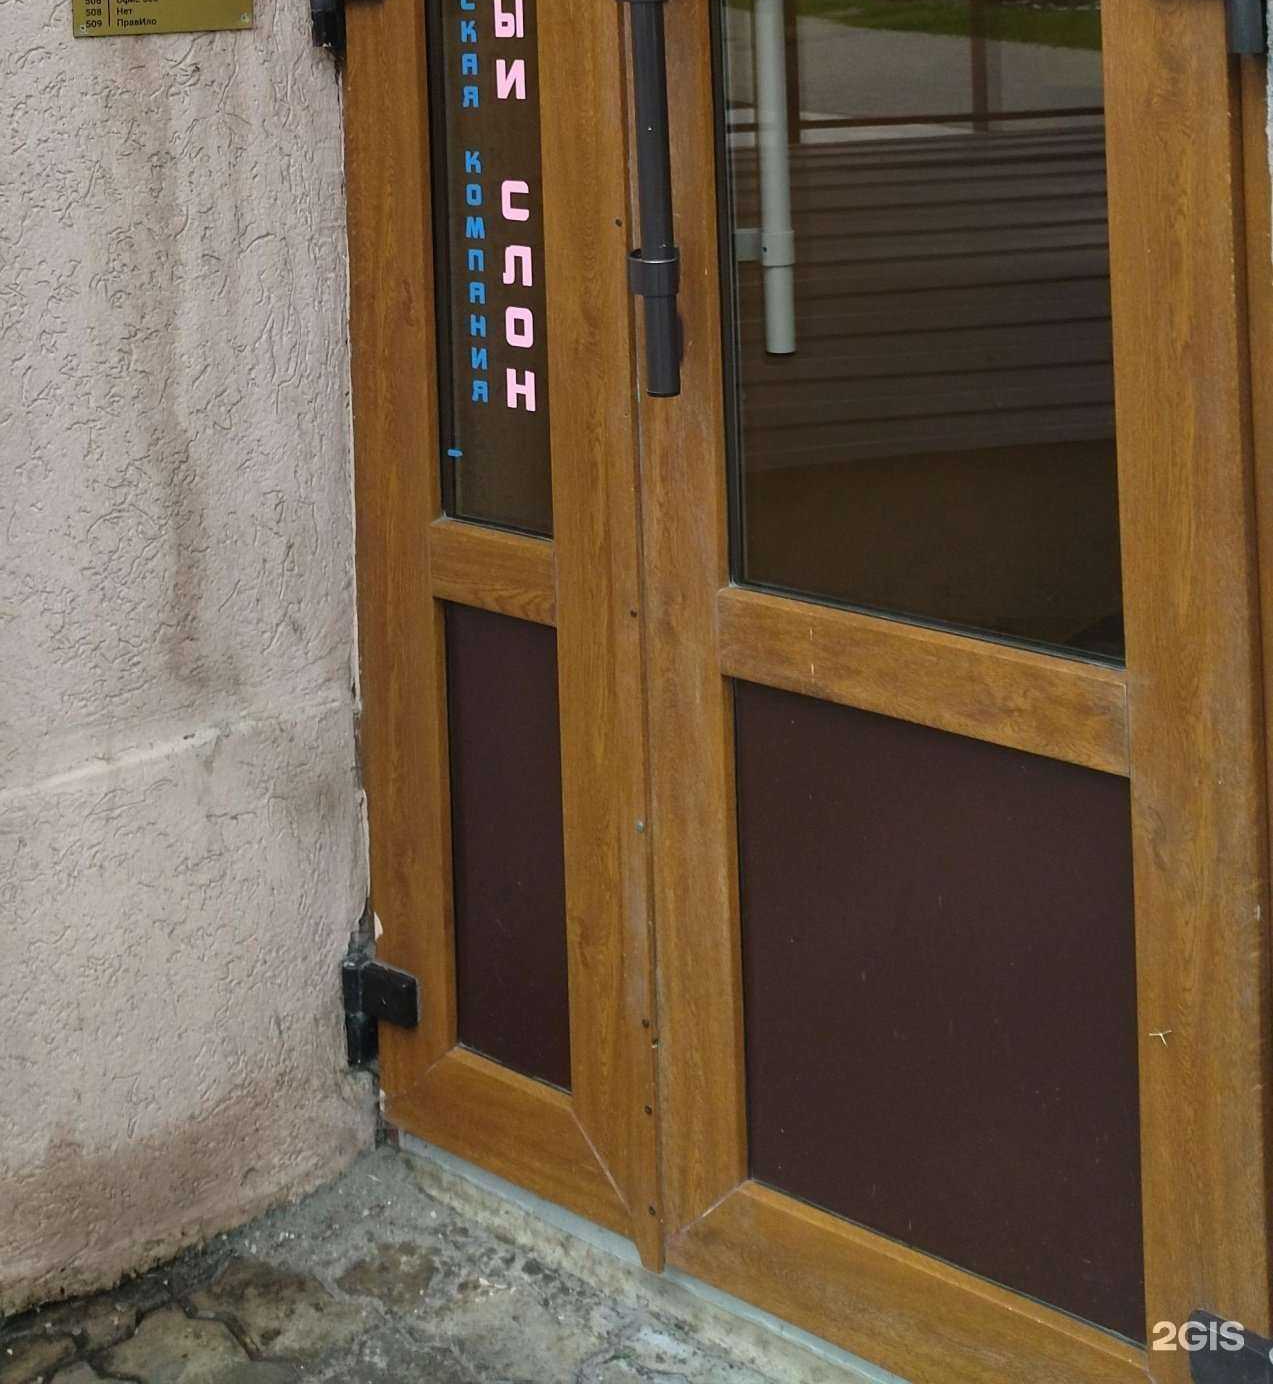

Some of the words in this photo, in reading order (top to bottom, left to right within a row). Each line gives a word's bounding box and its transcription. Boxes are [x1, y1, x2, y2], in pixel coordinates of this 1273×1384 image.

[86, 20, 103, 28] 509
[464, 150, 489, 403] КОМПАНИЯ
[501, 179, 536, 412] СЛОН
